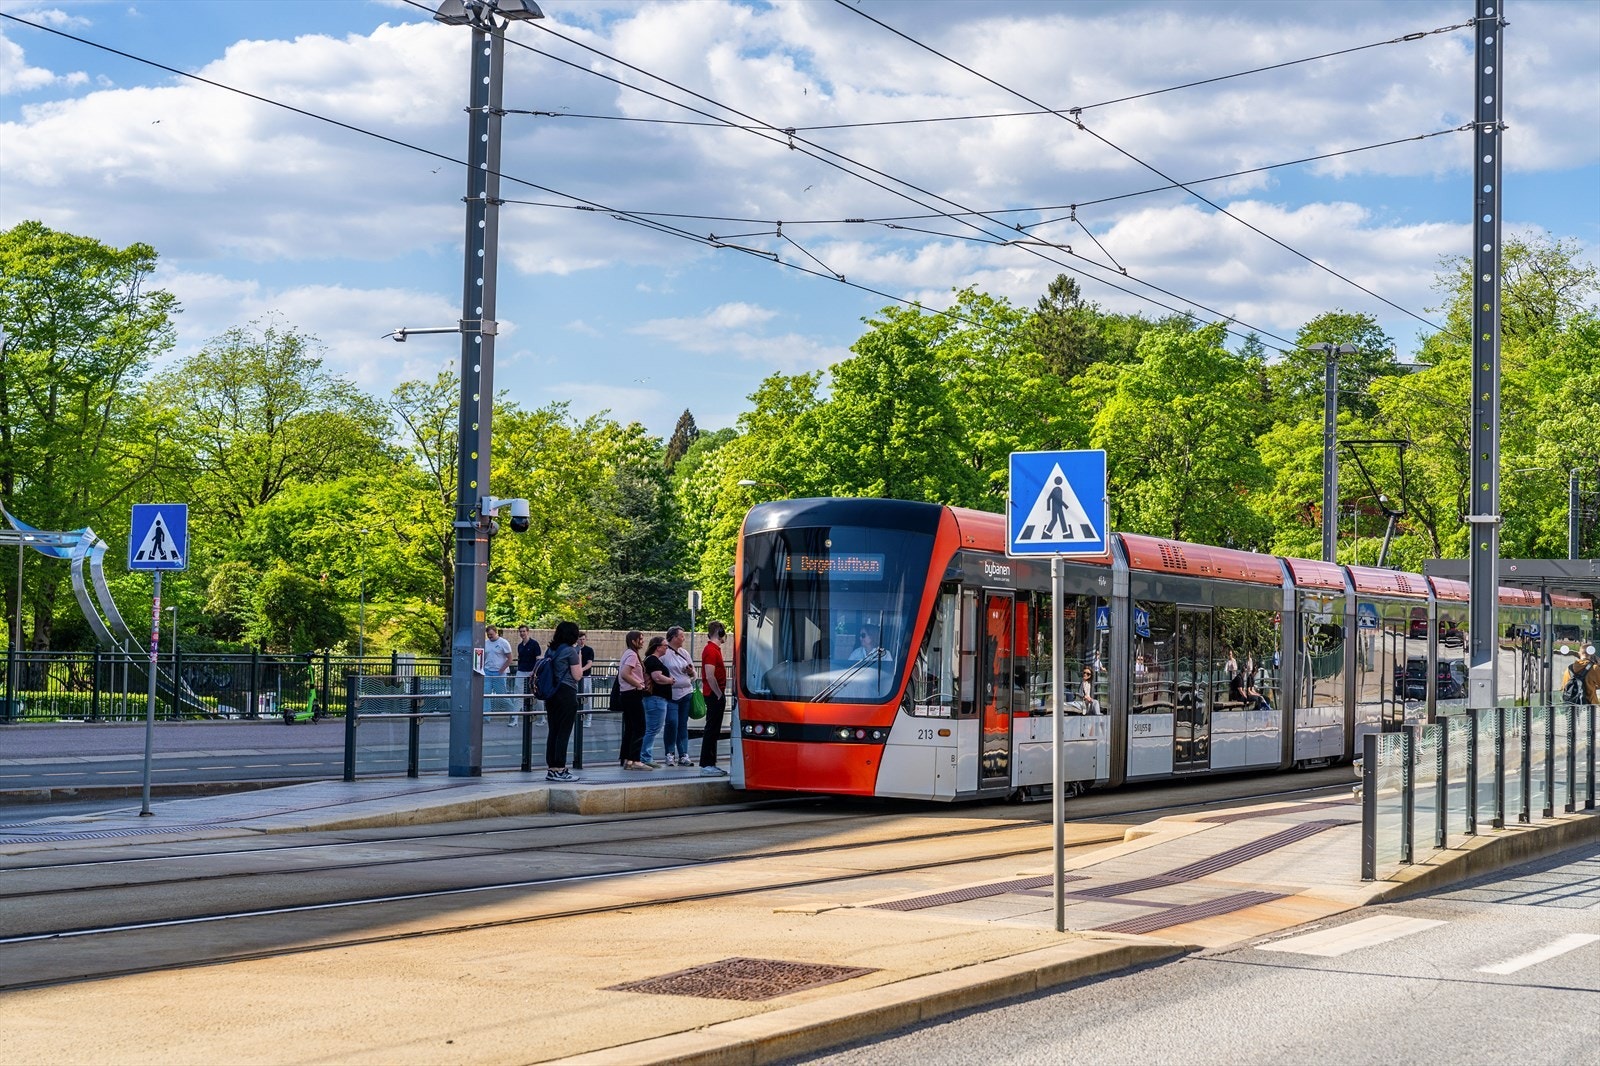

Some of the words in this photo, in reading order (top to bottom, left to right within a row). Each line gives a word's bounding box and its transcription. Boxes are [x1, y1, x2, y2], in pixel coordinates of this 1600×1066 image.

[785, 556, 791, 571] 1
[801, 556, 836, 574] Bergen
[984, 560, 1011, 577] bybanen
[918, 729, 934, 740] 213
